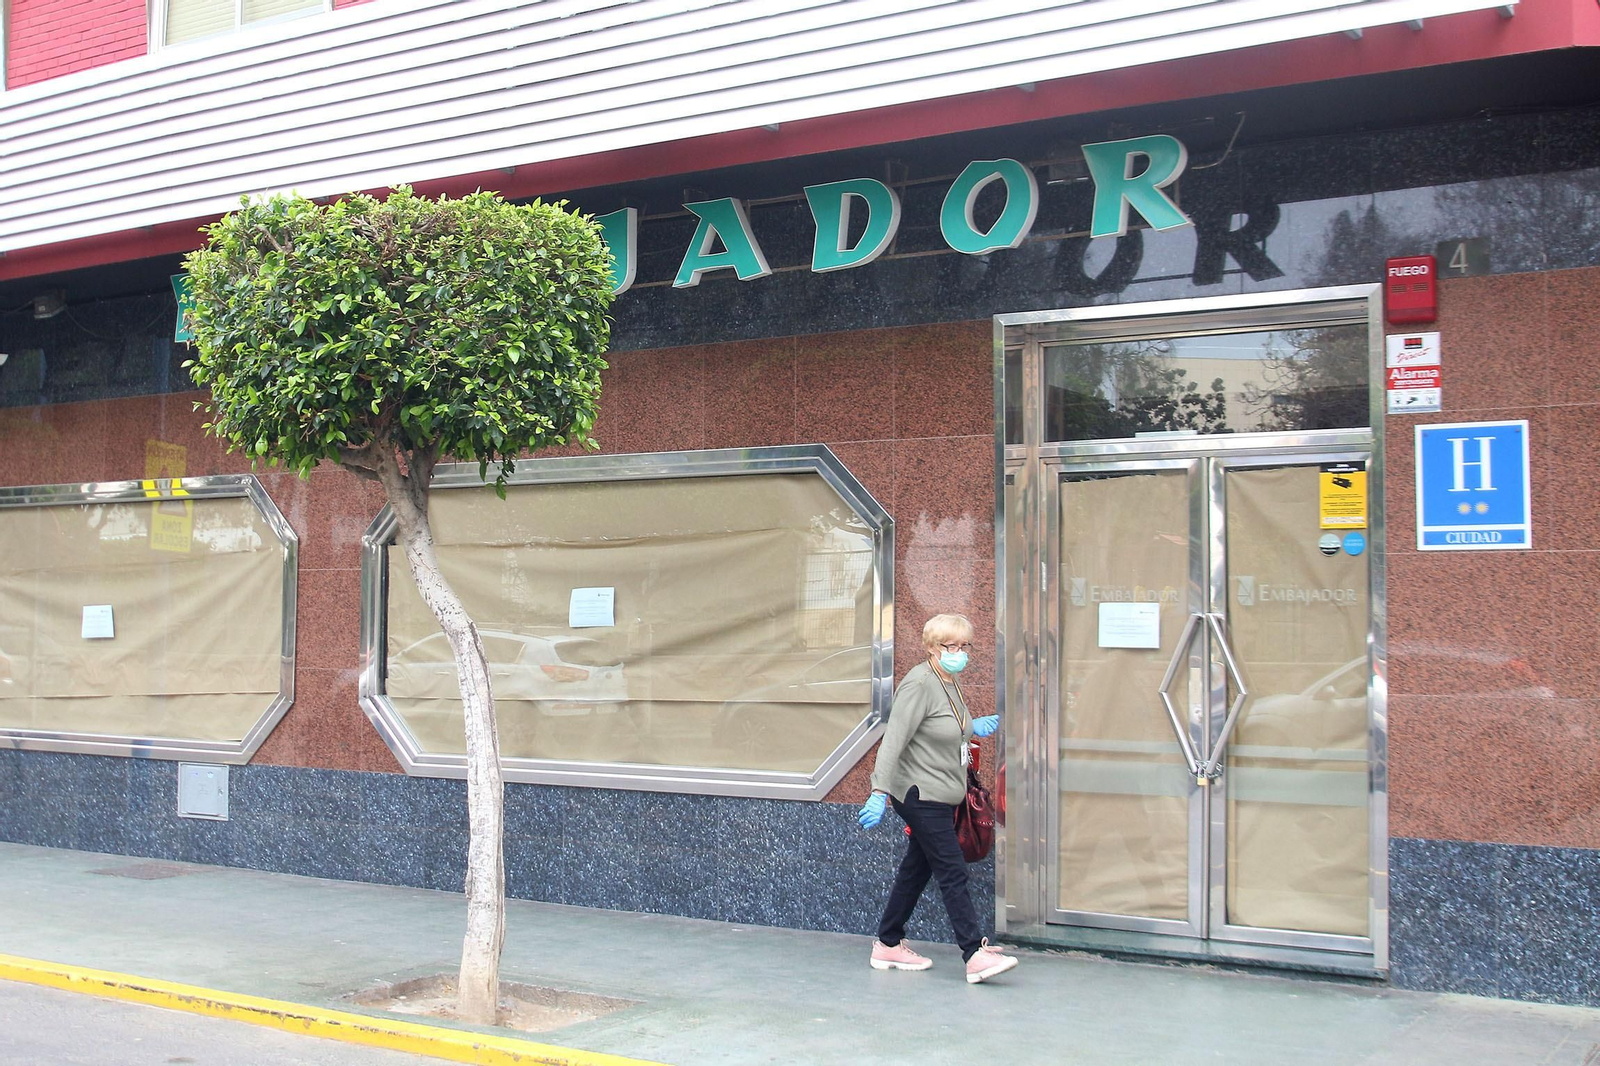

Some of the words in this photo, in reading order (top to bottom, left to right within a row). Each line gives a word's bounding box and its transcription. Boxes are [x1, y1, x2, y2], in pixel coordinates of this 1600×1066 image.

[1449, 243, 1468, 274] 4
[1388, 265, 1428, 277] FUEGO
[1389, 367, 1440, 380] Alarma
[1446, 436, 1498, 492] H
[1445, 531, 1502, 544] CIUDAD
[1259, 584, 1358, 606] EMBAJADOR
